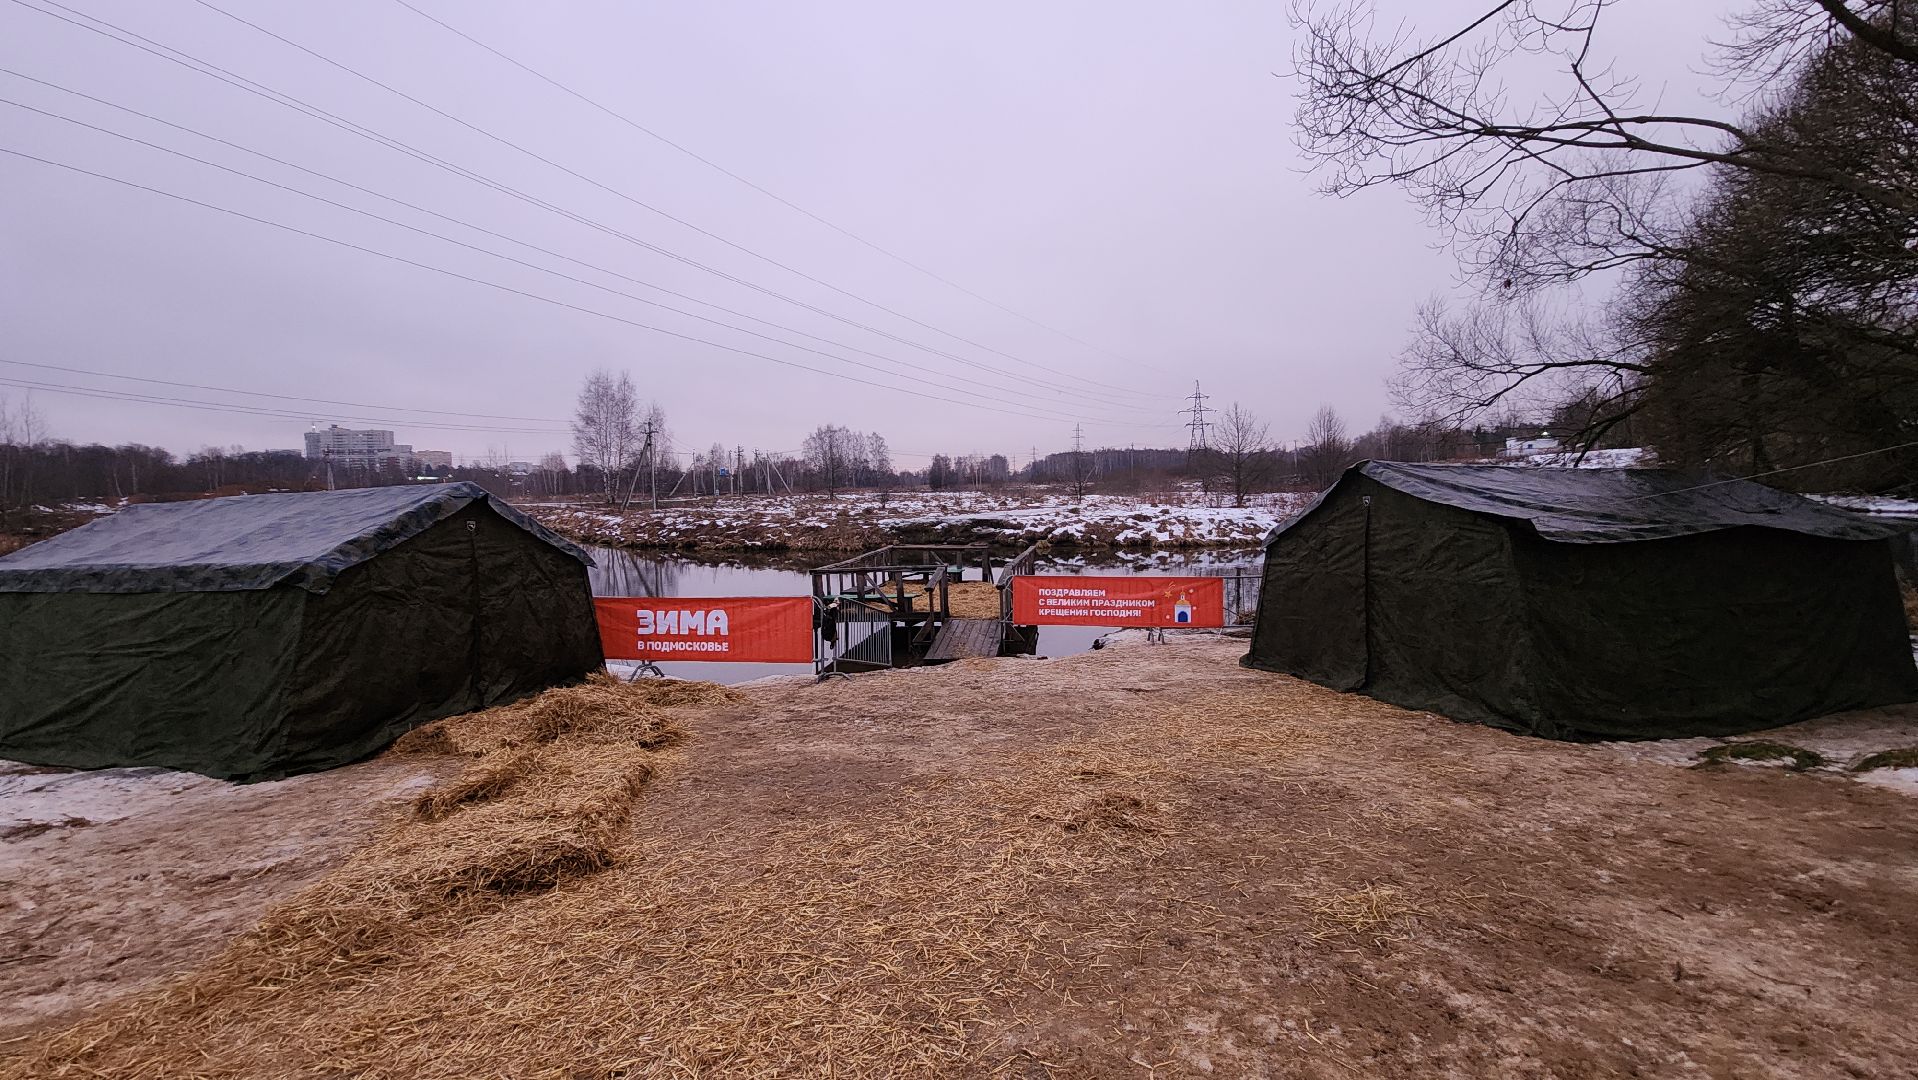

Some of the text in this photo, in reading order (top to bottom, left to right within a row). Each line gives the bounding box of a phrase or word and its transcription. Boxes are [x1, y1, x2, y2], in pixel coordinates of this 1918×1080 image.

[1039, 589, 1105, 597] ПОЗДРАВЛЯЕМ
[1092, 599, 1154, 608] ПРАЗДНИКОМ
[1039, 609, 1141, 618] КРЕЩЕНИЯ ГОСПОДНЯ!
[637, 609, 728, 635] ЗИМА
[637, 641, 729, 652] В ПОДМОСКОВЬЕ
